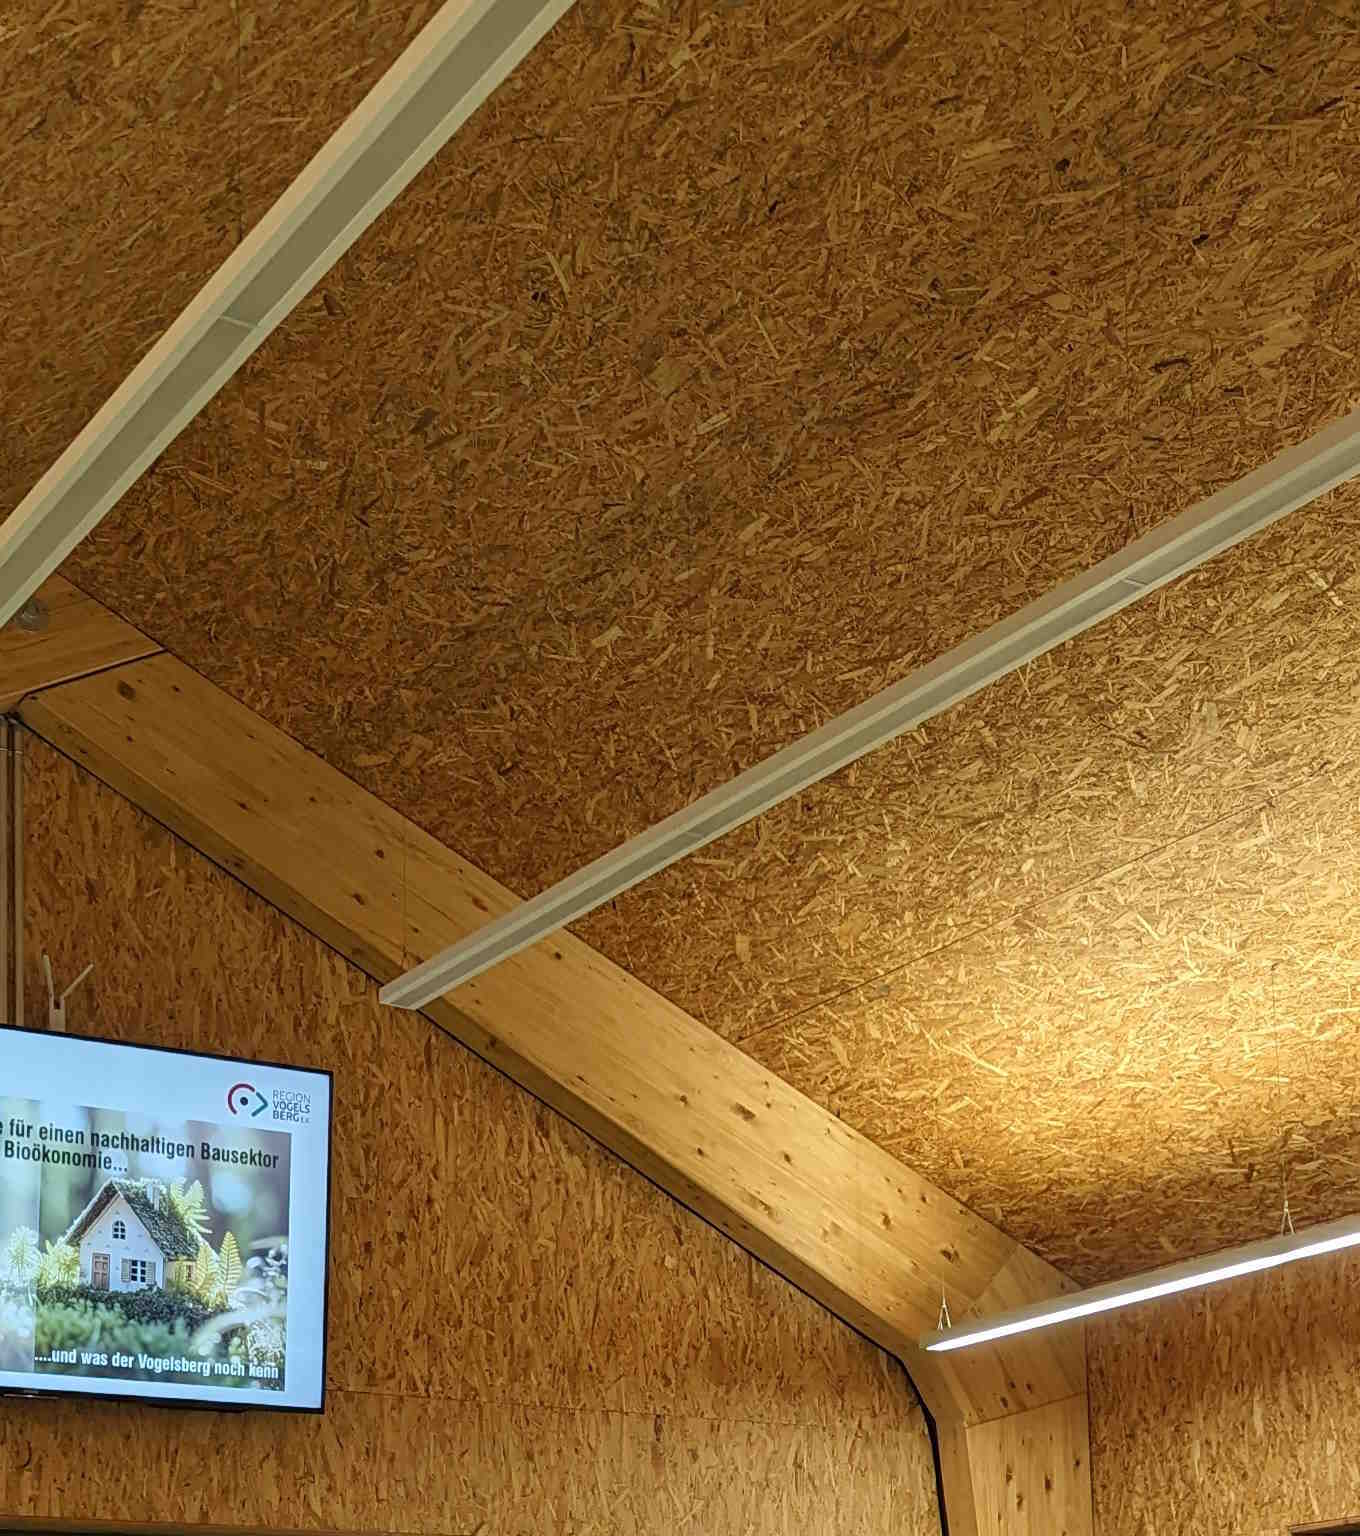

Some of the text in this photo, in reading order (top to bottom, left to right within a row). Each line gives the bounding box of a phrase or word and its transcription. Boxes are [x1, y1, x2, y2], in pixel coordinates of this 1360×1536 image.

[273, 1089, 311, 1103] REGION
[273, 1101, 311, 1114] VOGELS
[273, 1110, 299, 1122] BERG
[9, 1118, 33, 1139] für
[39, 1122, 85, 1145] einen
[90, 1130, 195, 1160] nachhaltigen
[201, 1142, 280, 1169] Bausektor
[4, 1140, 128, 1173] Bioökonomie...
[81, 1352, 108, 1366] was
[112, 1351, 134, 1369] der
[138, 1353, 210, 1377] Vogelsberg
[214, 1359, 245, 1377] noch
